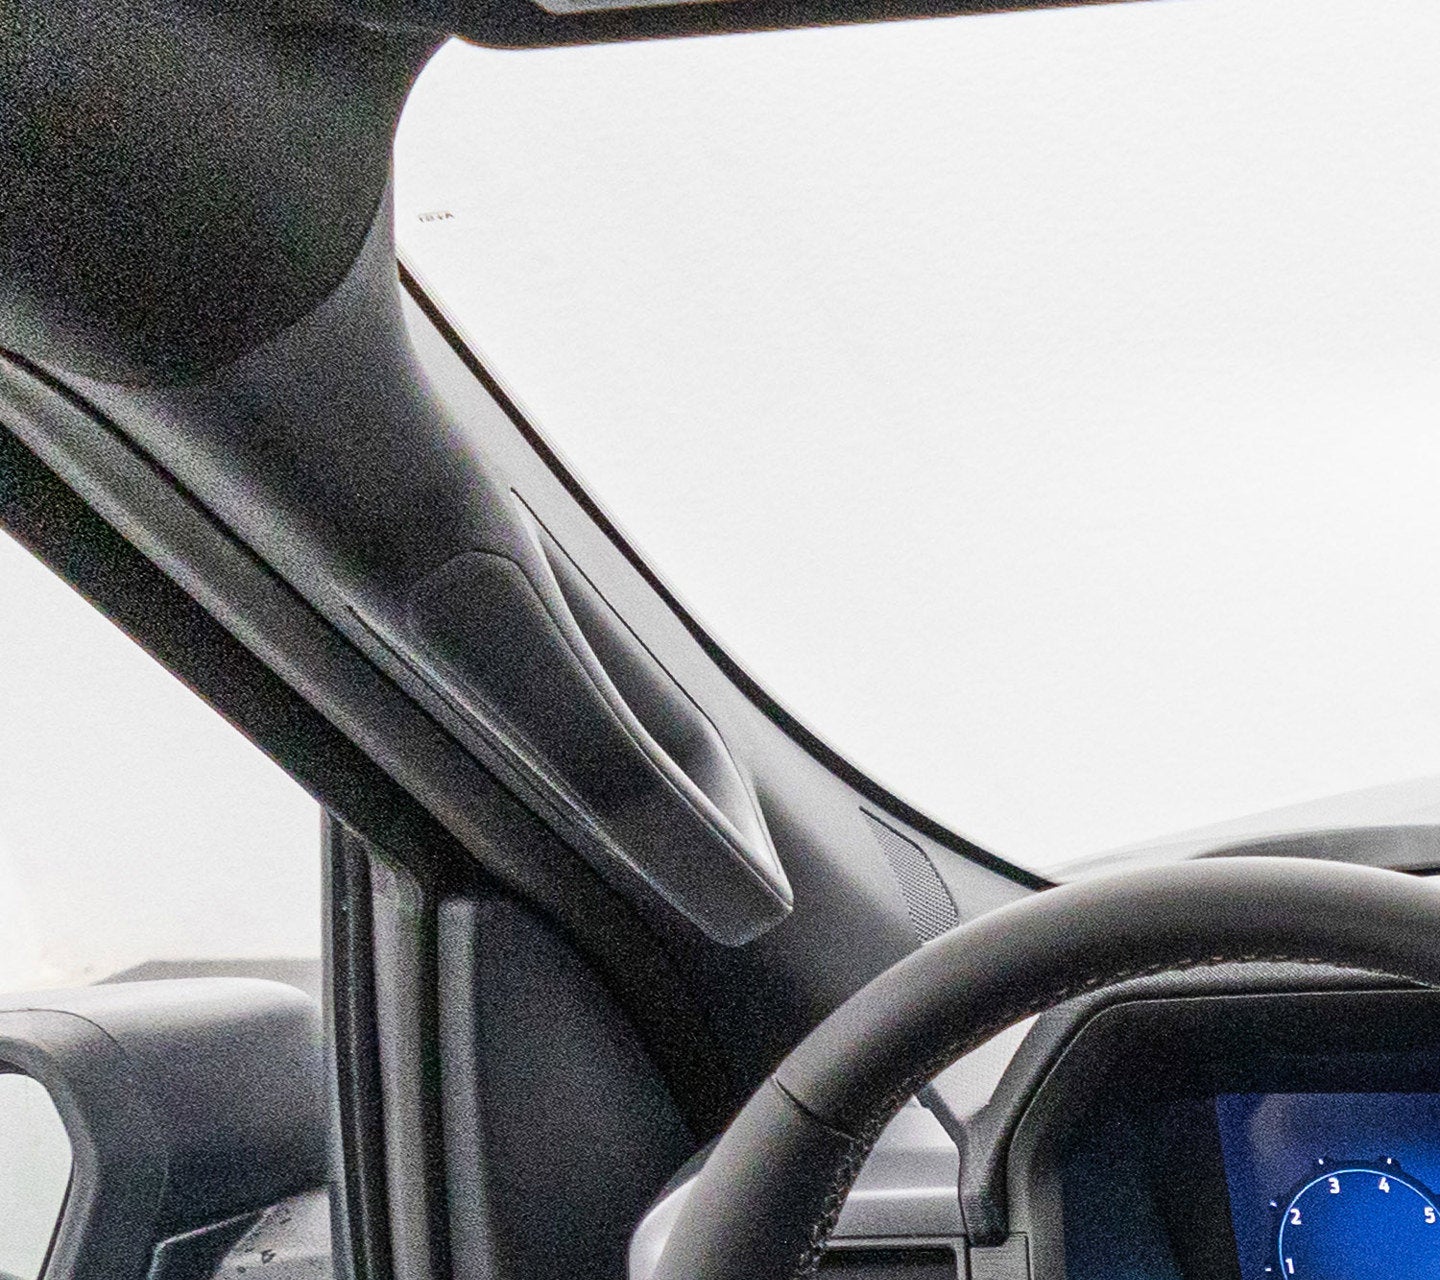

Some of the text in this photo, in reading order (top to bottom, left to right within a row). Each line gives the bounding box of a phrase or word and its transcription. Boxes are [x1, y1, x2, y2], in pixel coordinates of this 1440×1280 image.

[1328, 1177, 1340, 1194] 3
[1378, 1177, 1390, 1194] 4
[1289, 1208, 1302, 1226] 2
[1423, 1207, 1436, 1224] 5
[1285, 1258, 1295, 1274] 1
